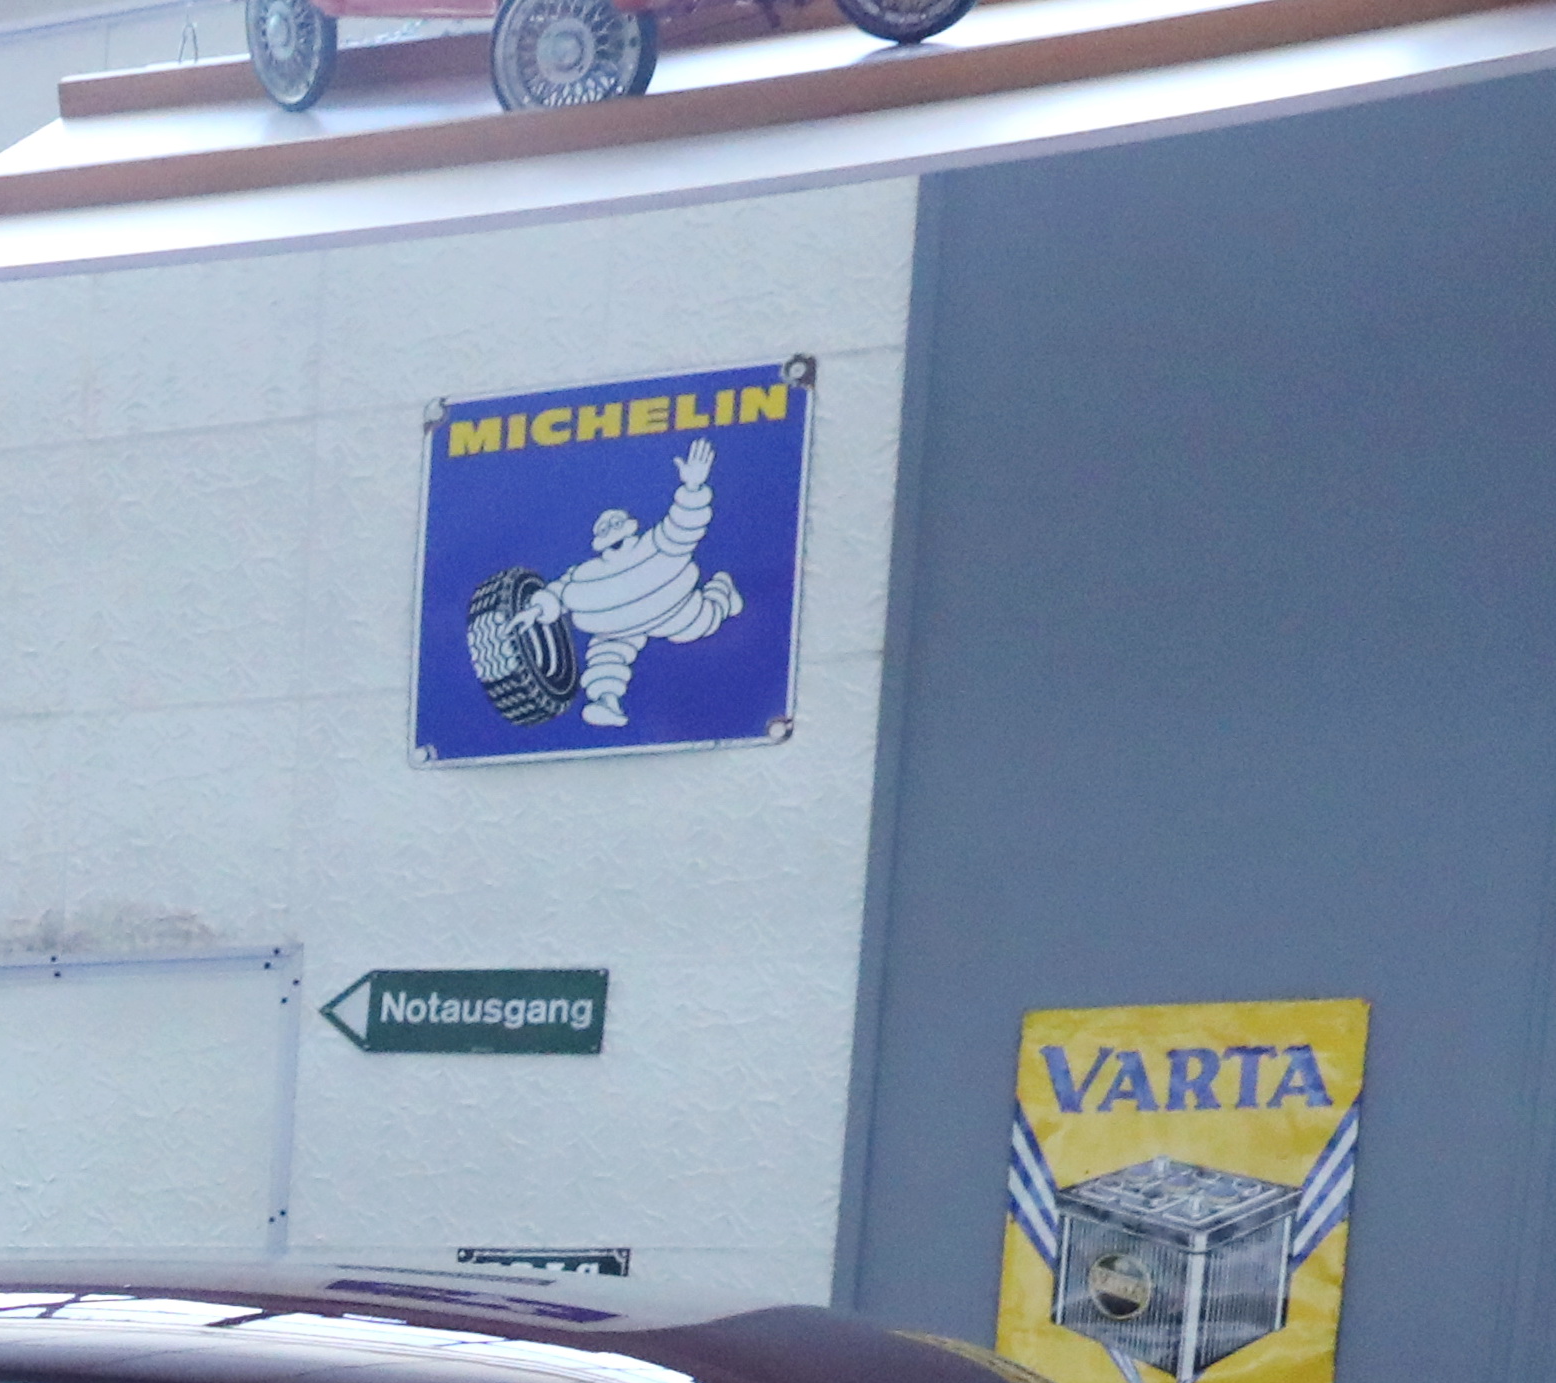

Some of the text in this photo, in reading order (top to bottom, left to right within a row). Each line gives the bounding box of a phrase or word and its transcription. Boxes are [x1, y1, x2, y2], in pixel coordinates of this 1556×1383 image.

[448, 384, 790, 457] MICHELIN
[379, 991, 594, 1030] Notausgang
[1039, 1044, 1334, 1114] VARTA
